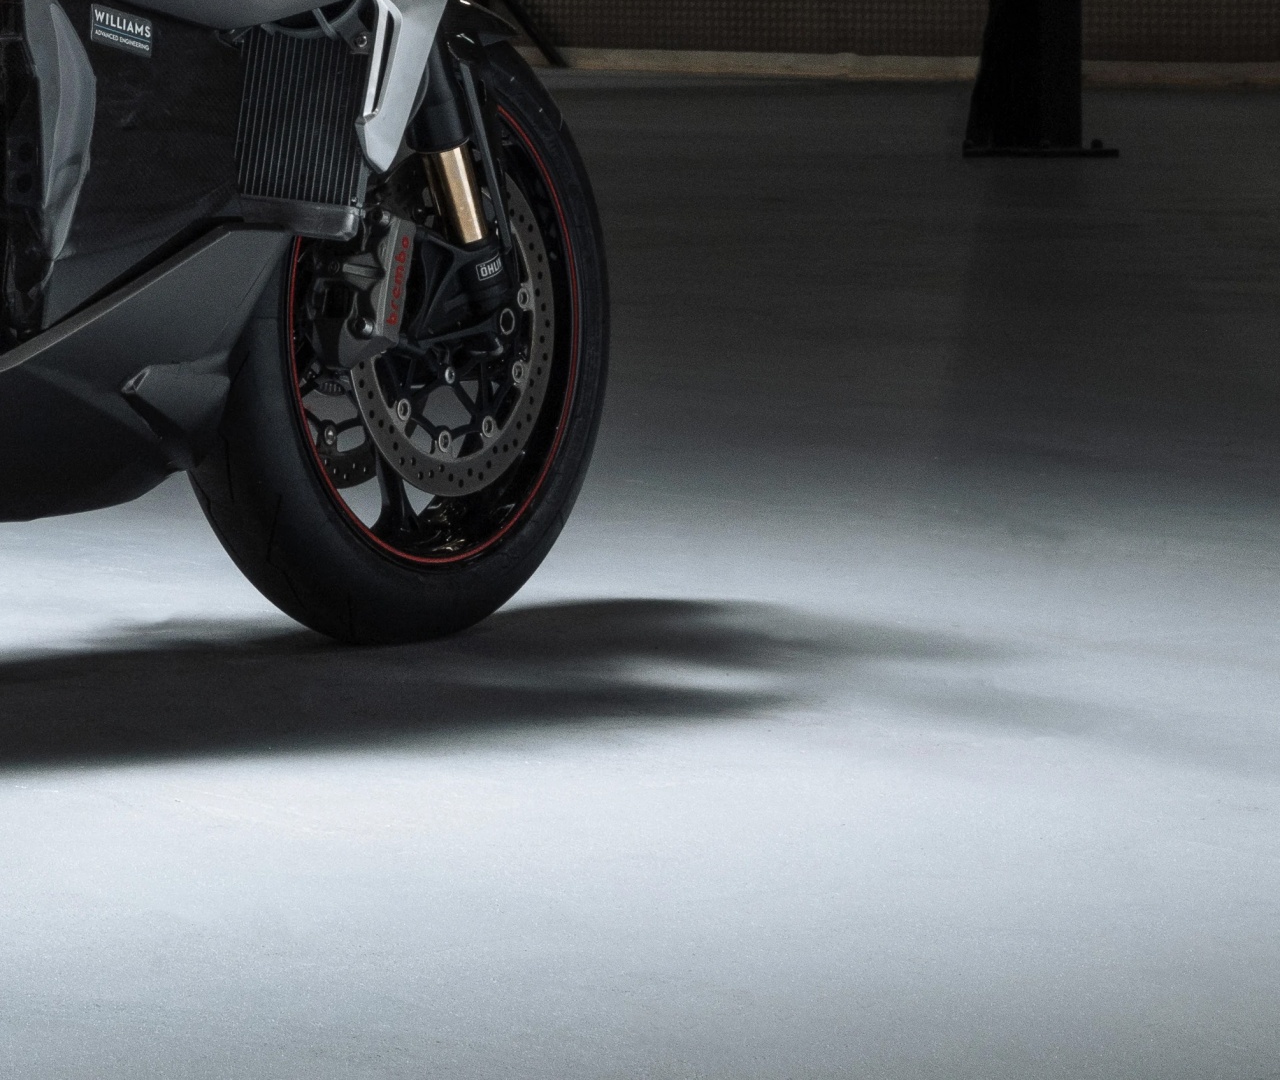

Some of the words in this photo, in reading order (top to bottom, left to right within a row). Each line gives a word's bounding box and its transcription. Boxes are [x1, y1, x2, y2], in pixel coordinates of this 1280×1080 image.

[94, 9, 151, 38] WILLIAMS
[95, 29, 118, 41] ADVANCED
[119, 36, 149, 51] ENGINEERING
[386, 235, 409, 325] brembo
